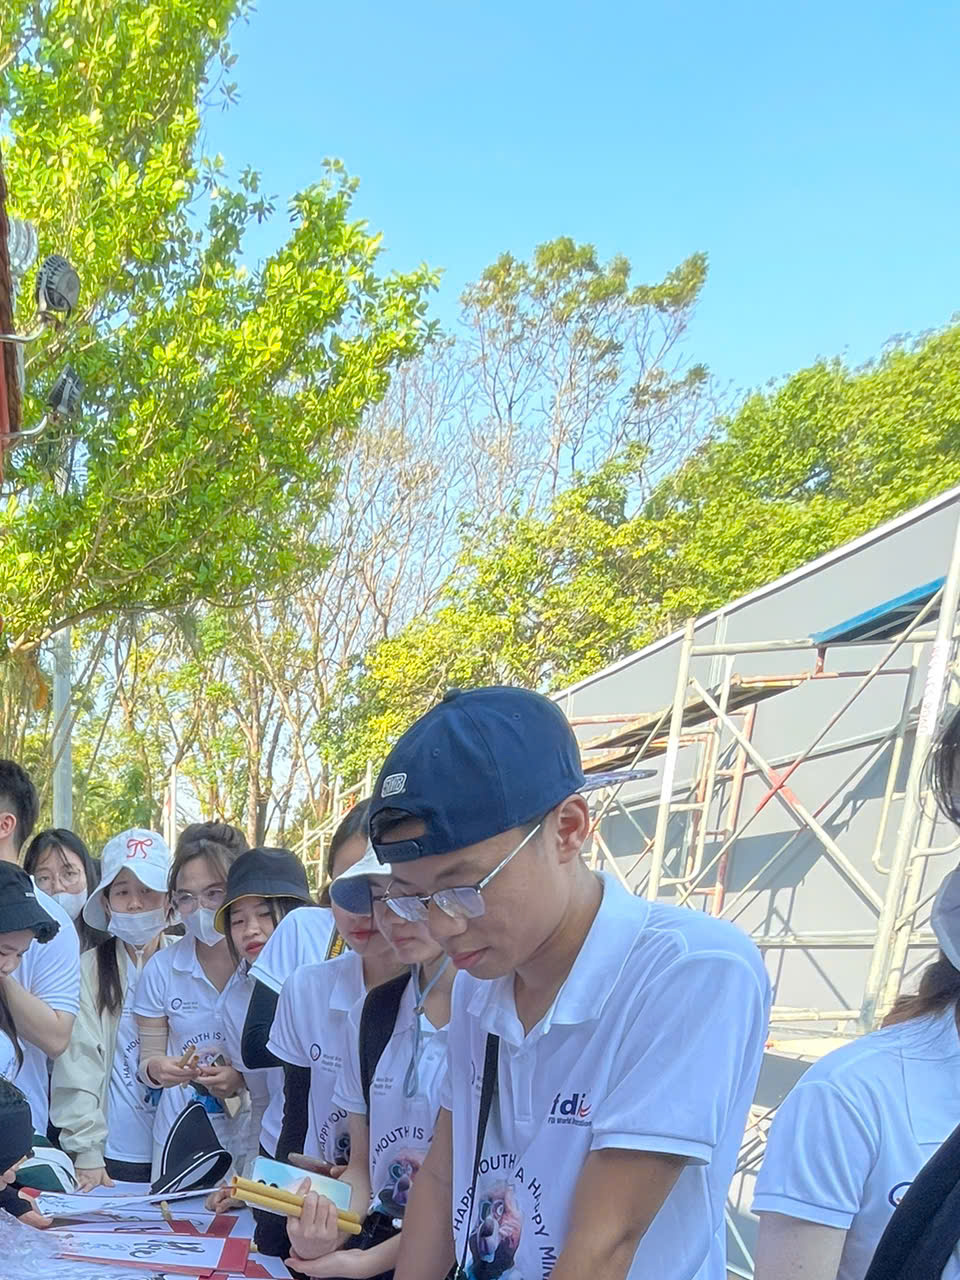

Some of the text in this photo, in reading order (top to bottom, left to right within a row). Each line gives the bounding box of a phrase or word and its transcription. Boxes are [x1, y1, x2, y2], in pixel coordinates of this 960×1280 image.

[213, 1032, 222, 1040] IS
[550, 1092, 588, 1117] fdi
[413, 1126, 424, 1140] IS
[477, 1153, 517, 1176] OUTH
[515, 1167, 525, 1183] A
